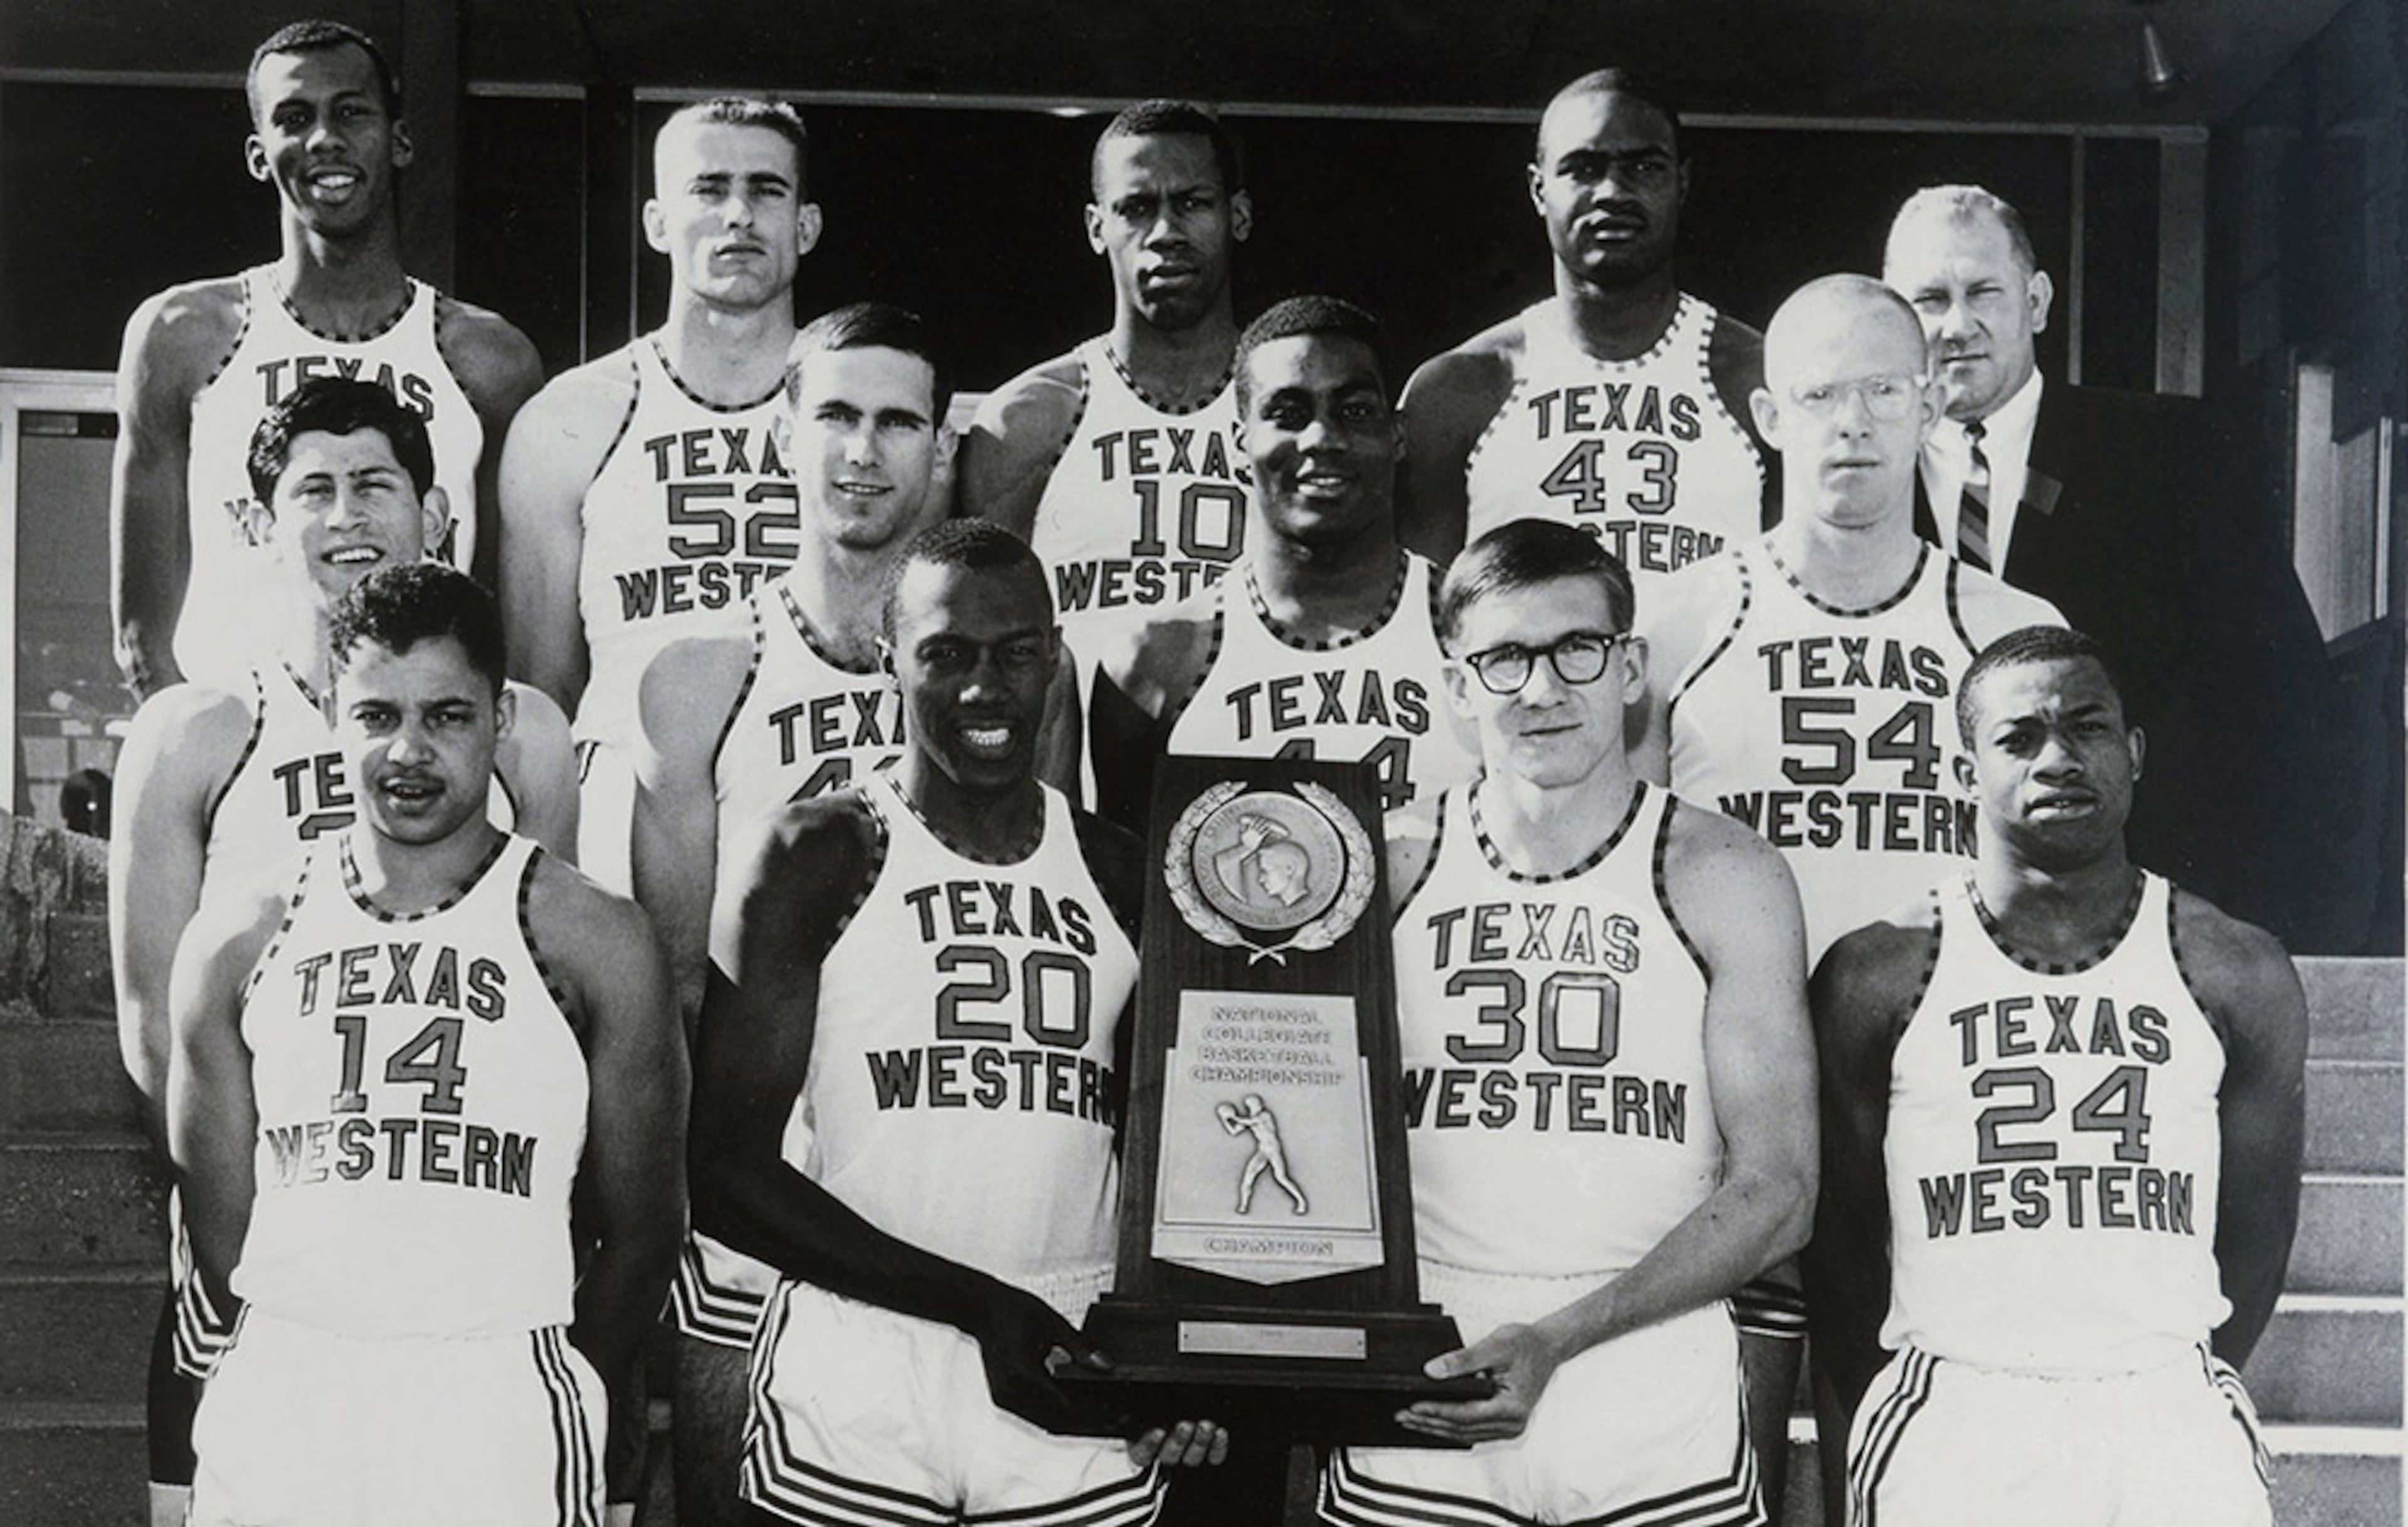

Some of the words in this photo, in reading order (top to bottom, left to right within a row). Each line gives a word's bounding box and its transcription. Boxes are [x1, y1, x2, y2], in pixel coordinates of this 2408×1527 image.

[1528, 383, 1701, 440] TEXAS
[644, 428, 790, 482] TEXA
[1539, 439, 1679, 515] 43
[667, 482, 801, 560] 52
[1131, 479, 1247, 563] 10
[1576, 520, 1725, 573] TERN
[614, 561, 793, 622] WEST
[1055, 559, 1231, 615] WEST
[1758, 636, 1950, 699] TEXAS
[768, 689, 905, 766] TEX
[1225, 669, 1430, 742] TEXAS
[1781, 696, 1941, 791] 54
[1718, 790, 1979, 860] WESTERN
[904, 880, 1097, 956] TEXAS
[1427, 903, 1640, 973] TEXAS
[293, 942, 507, 1023] TEXAS
[935, 944, 1092, 1050] 20
[1211, 1005, 1323, 1025] NATIONAL
[1445, 969, 1621, 1067] 30
[330, 1015, 468, 1115] 14
[1196, 1044, 1335, 1066] BASKETBALL
[1201, 1024, 1332, 1045] COLLEGIATE
[1950, 995, 2171, 1067] TEXAS
[1188, 1065, 1344, 1087] CHAMPIONSHIP
[1404, 1067, 1688, 1145] WESTERN
[1972, 1065, 2152, 1164] 24
[265, 1117, 538, 1198] WESTERN
[1919, 1165, 2195, 1240] WESTERN
[1203, 1235, 1334, 1256] CHAMPION
